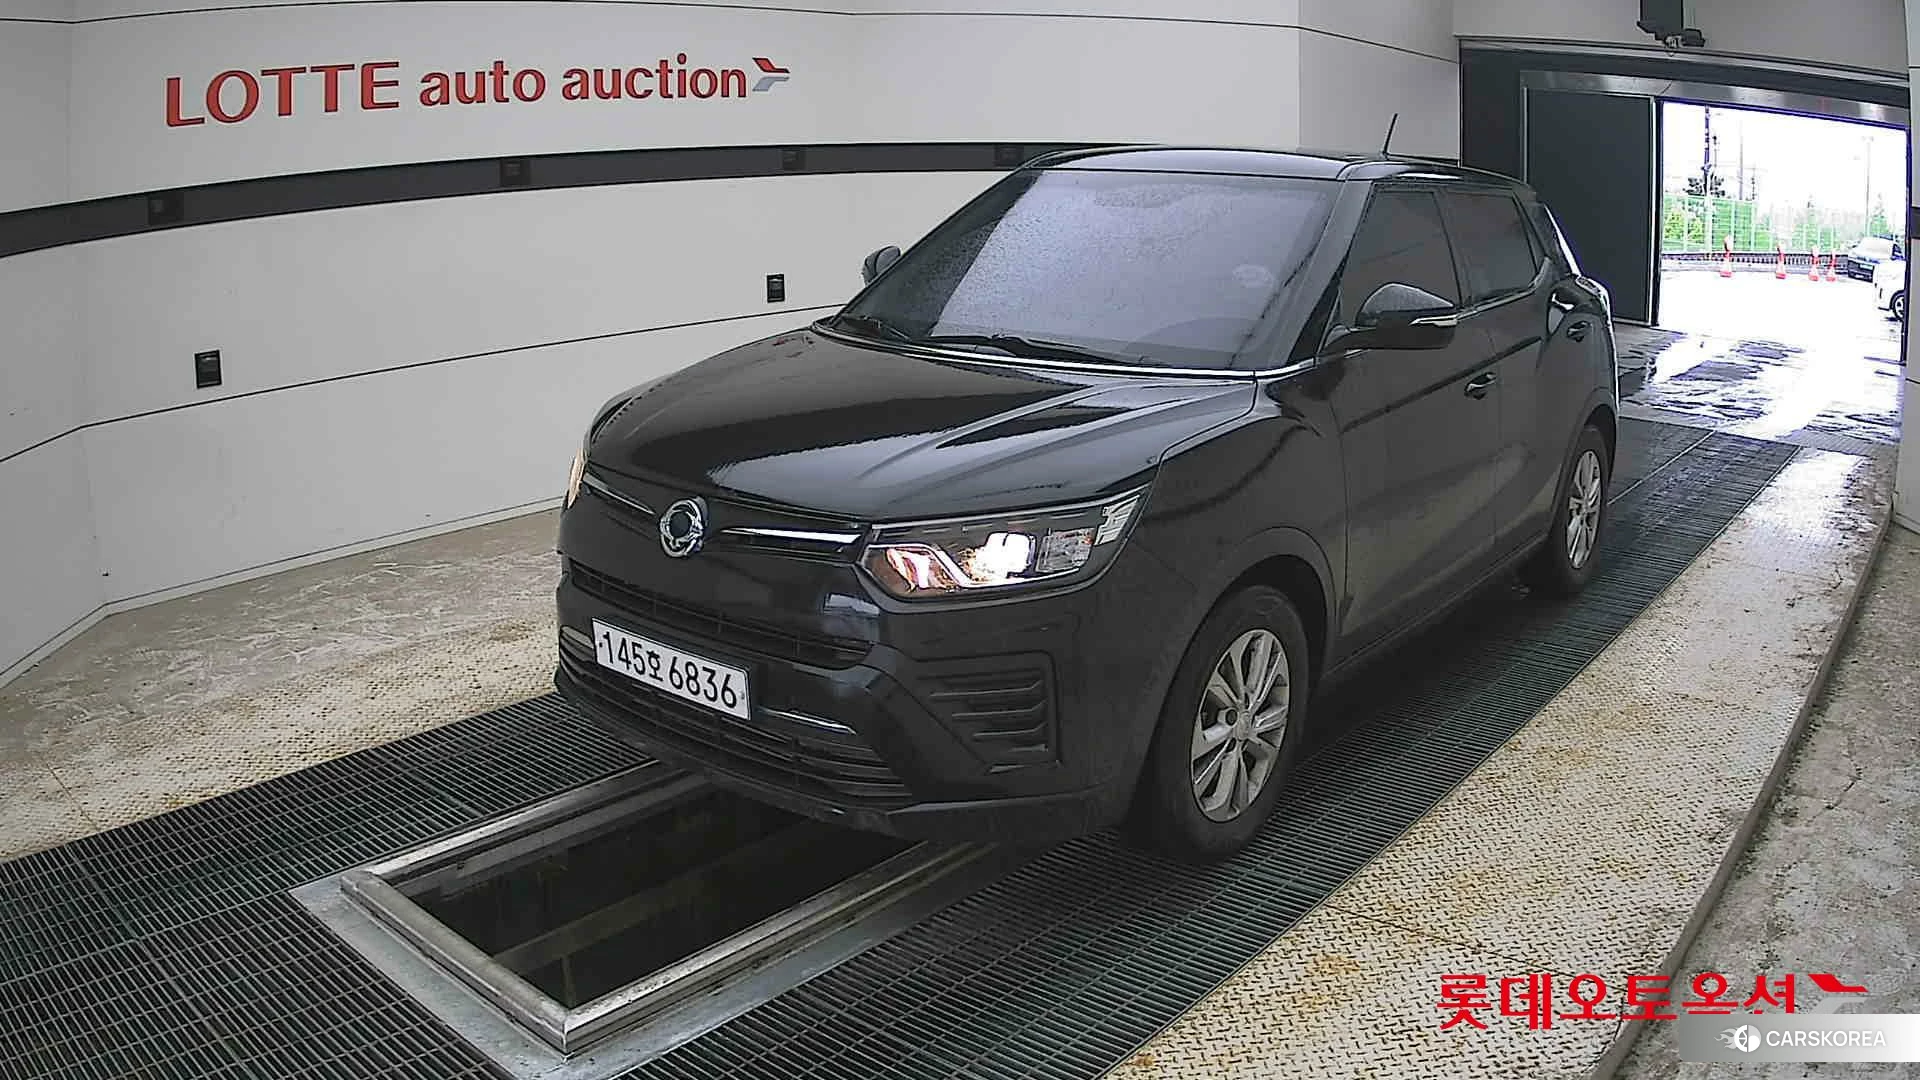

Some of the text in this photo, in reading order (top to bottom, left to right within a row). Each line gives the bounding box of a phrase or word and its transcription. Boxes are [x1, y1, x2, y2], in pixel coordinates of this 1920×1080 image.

[165, 53, 748, 127] LOTTE auto auction
[603, 631, 737, 709] 145호 6836
